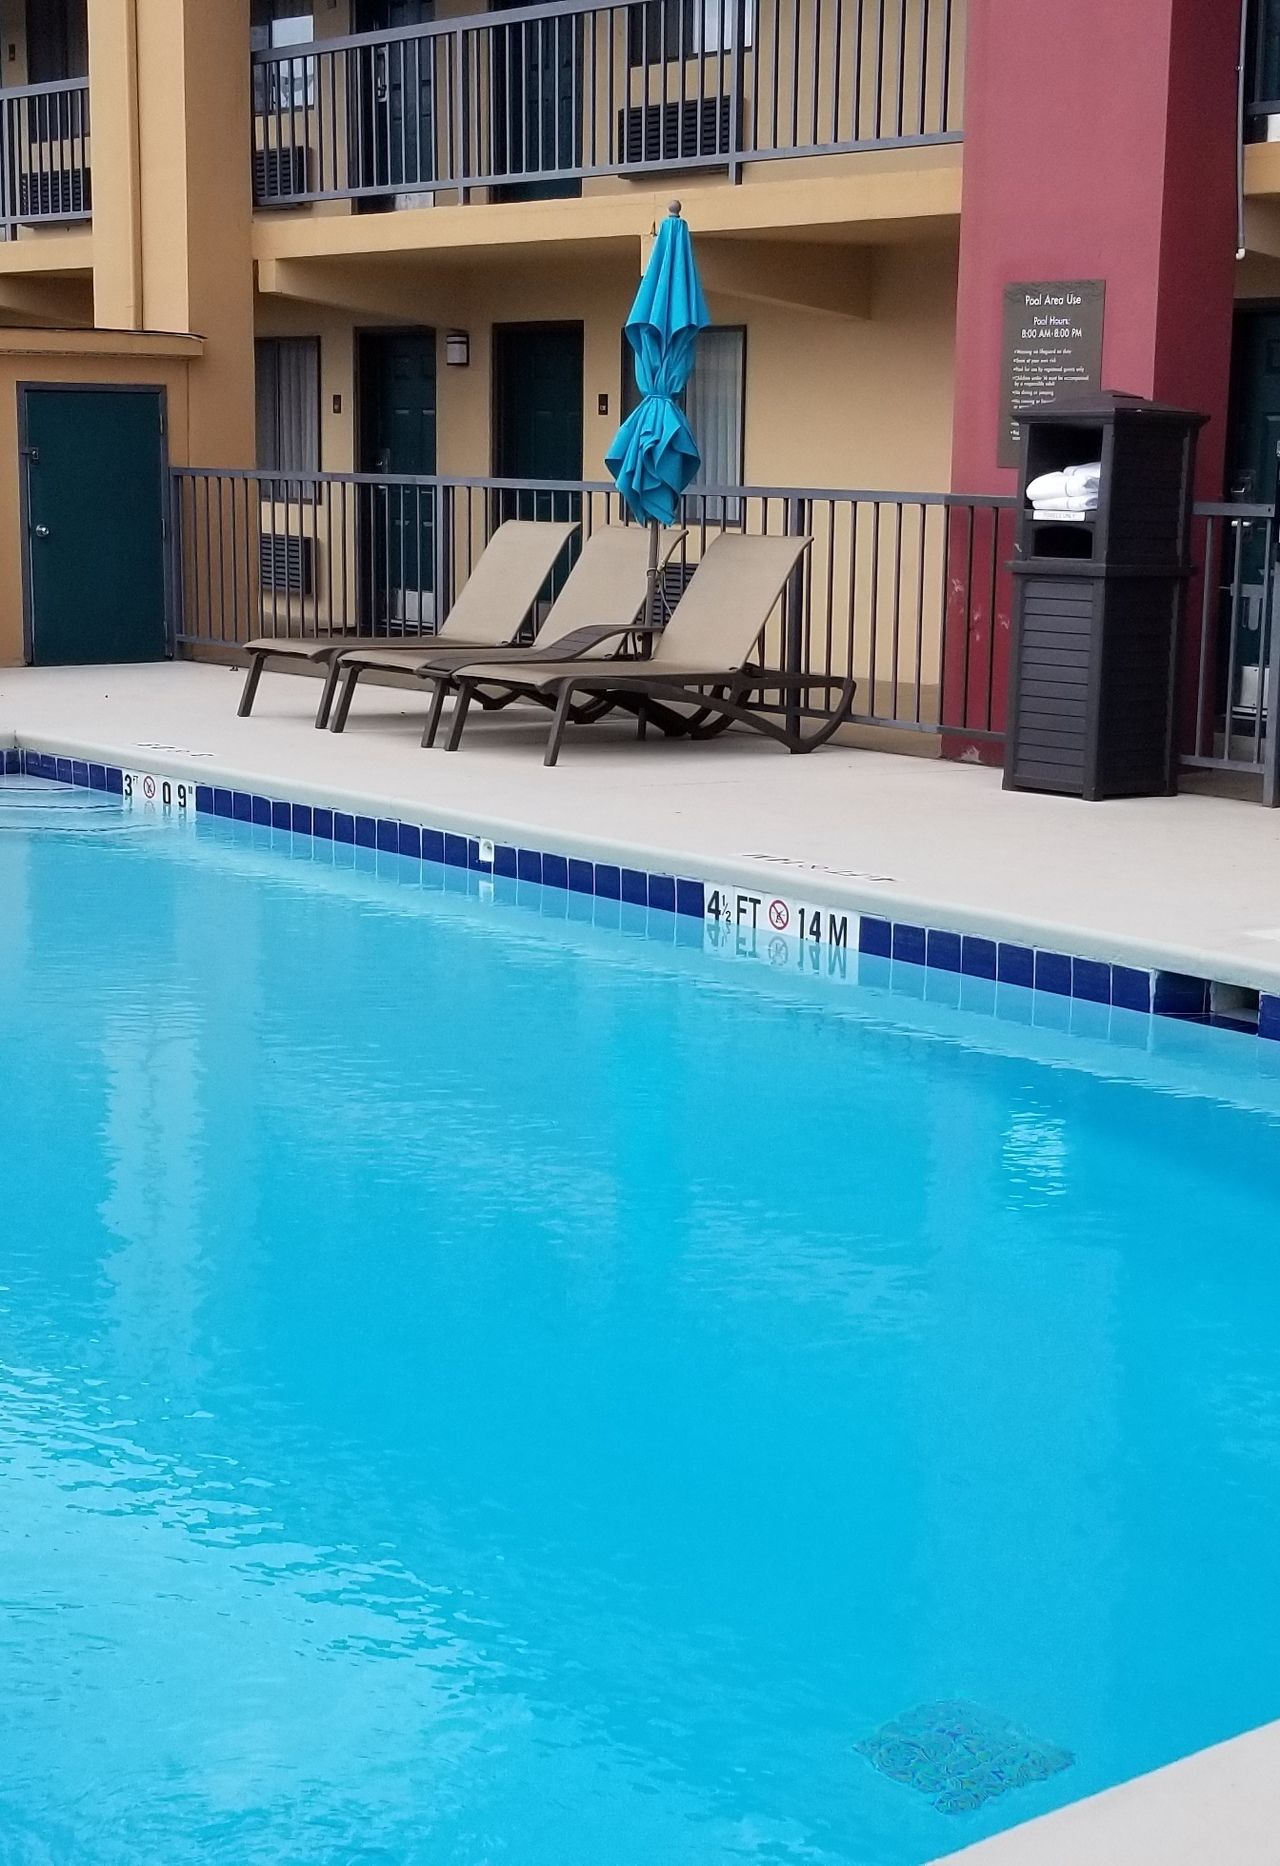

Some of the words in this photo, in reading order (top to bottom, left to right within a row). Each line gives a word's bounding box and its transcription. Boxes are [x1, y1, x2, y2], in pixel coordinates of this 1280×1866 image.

[1025, 294, 1042, 306] Pool
[1044, 294, 1064, 305] Area
[1066, 293, 1082, 305] Use
[1033, 315, 1048, 326] Pool
[1071, 328, 1083, 338] PM
[736, 894, 761, 929] FT
